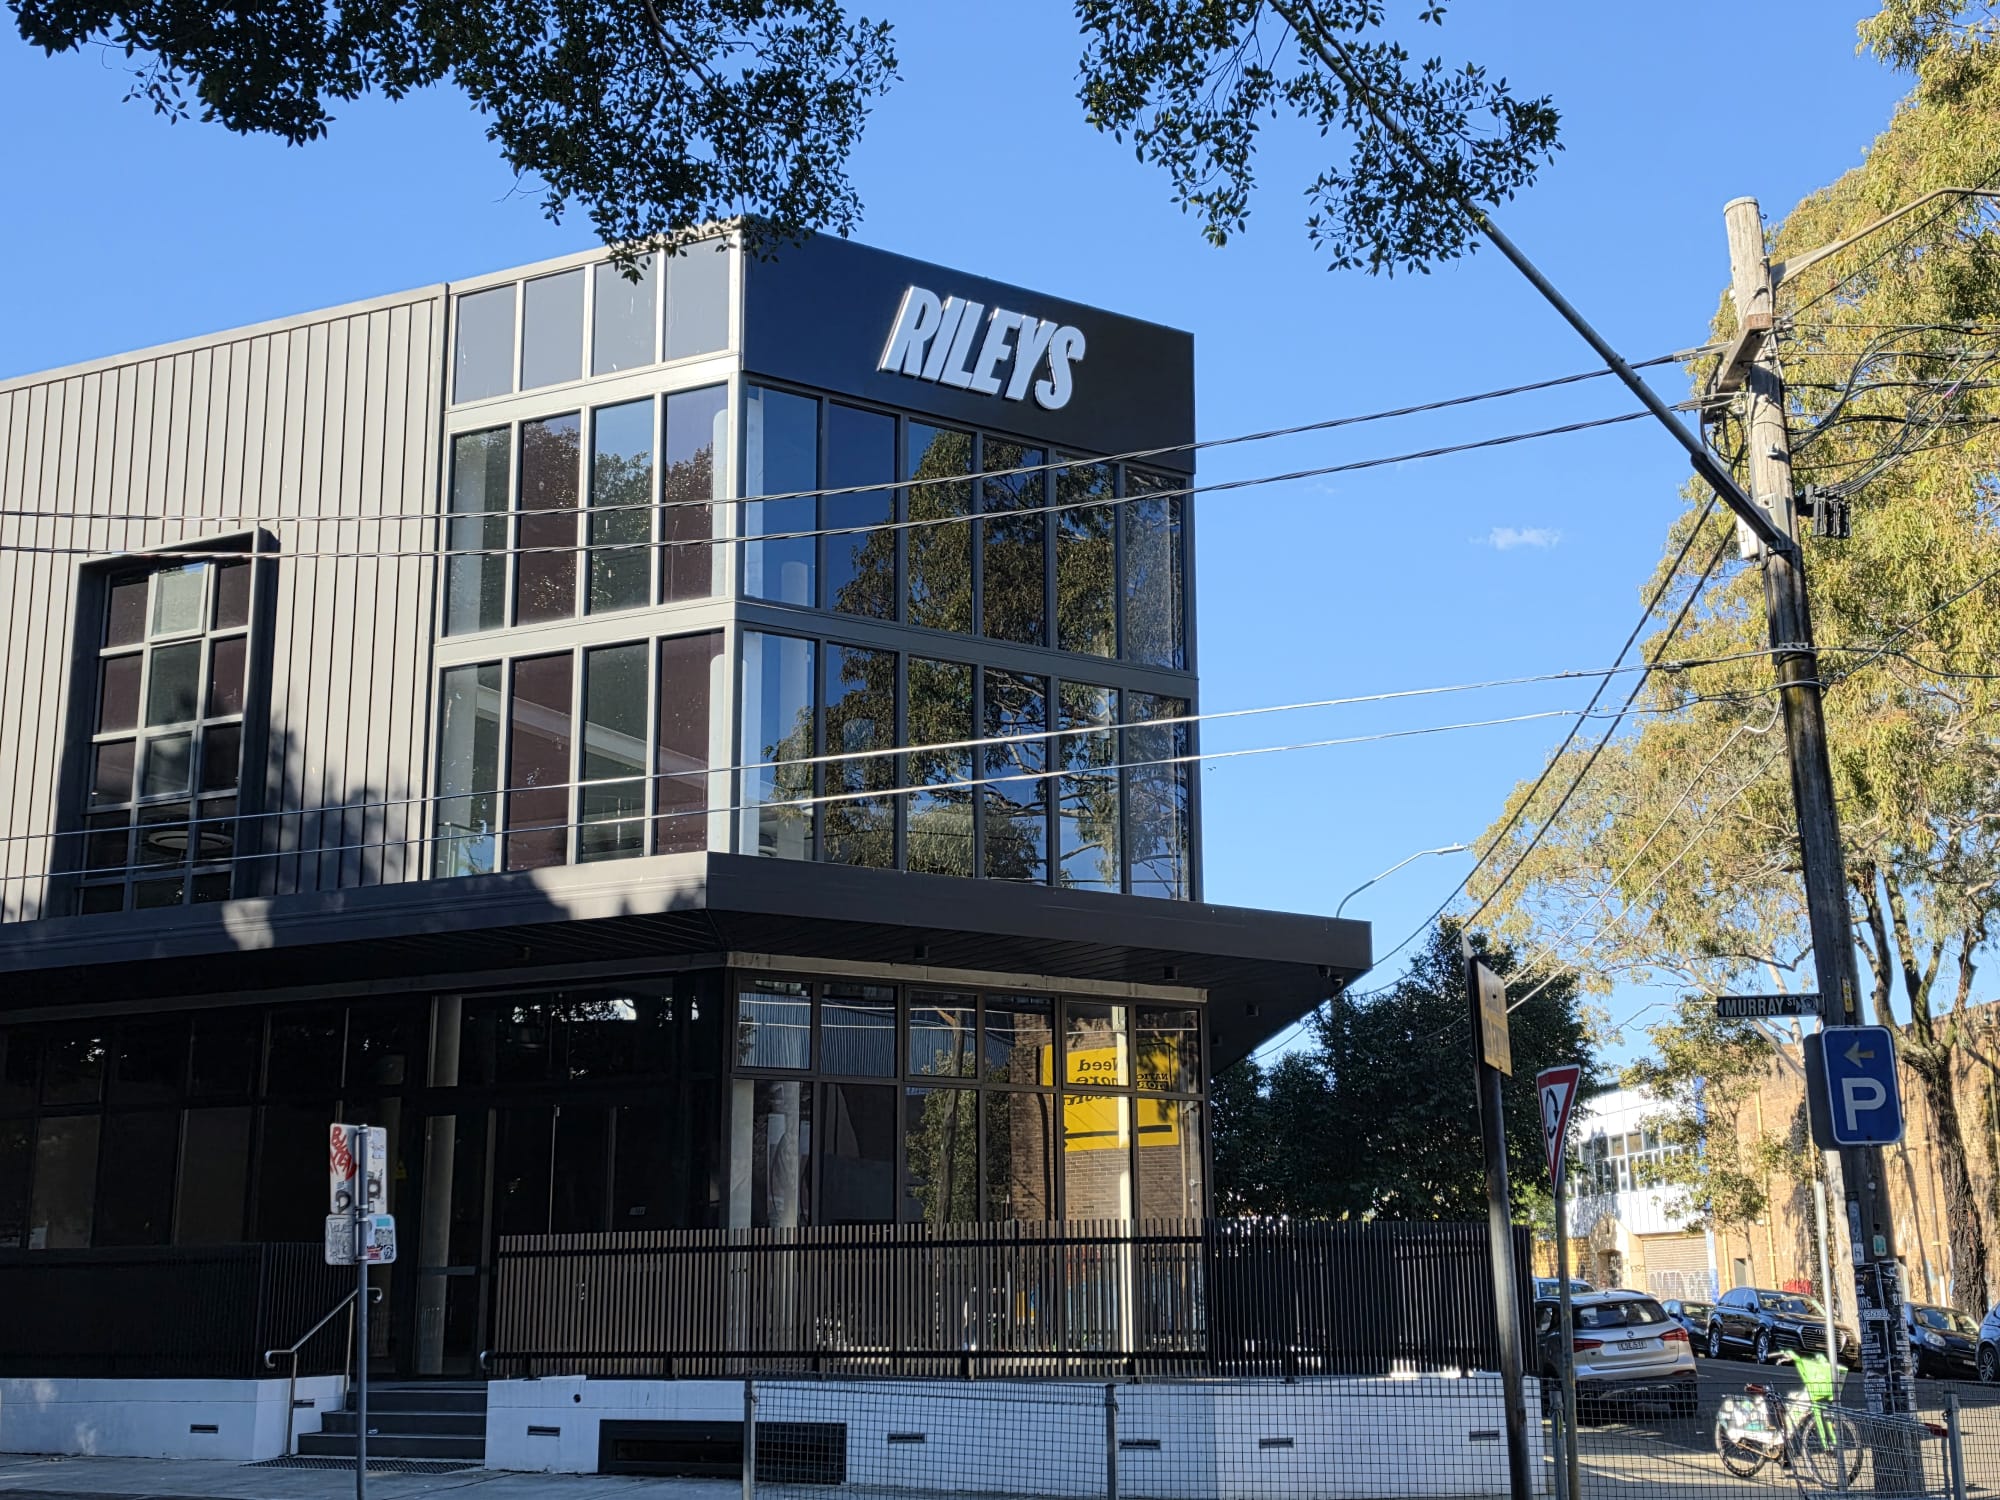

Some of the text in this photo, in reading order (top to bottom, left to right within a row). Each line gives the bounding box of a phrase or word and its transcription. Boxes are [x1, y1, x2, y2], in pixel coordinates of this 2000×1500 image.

[877, 284, 1086, 411] RILEYS
[1724, 997, 1785, 1017] MURRAY
[1840, 1077, 1887, 1132] P
